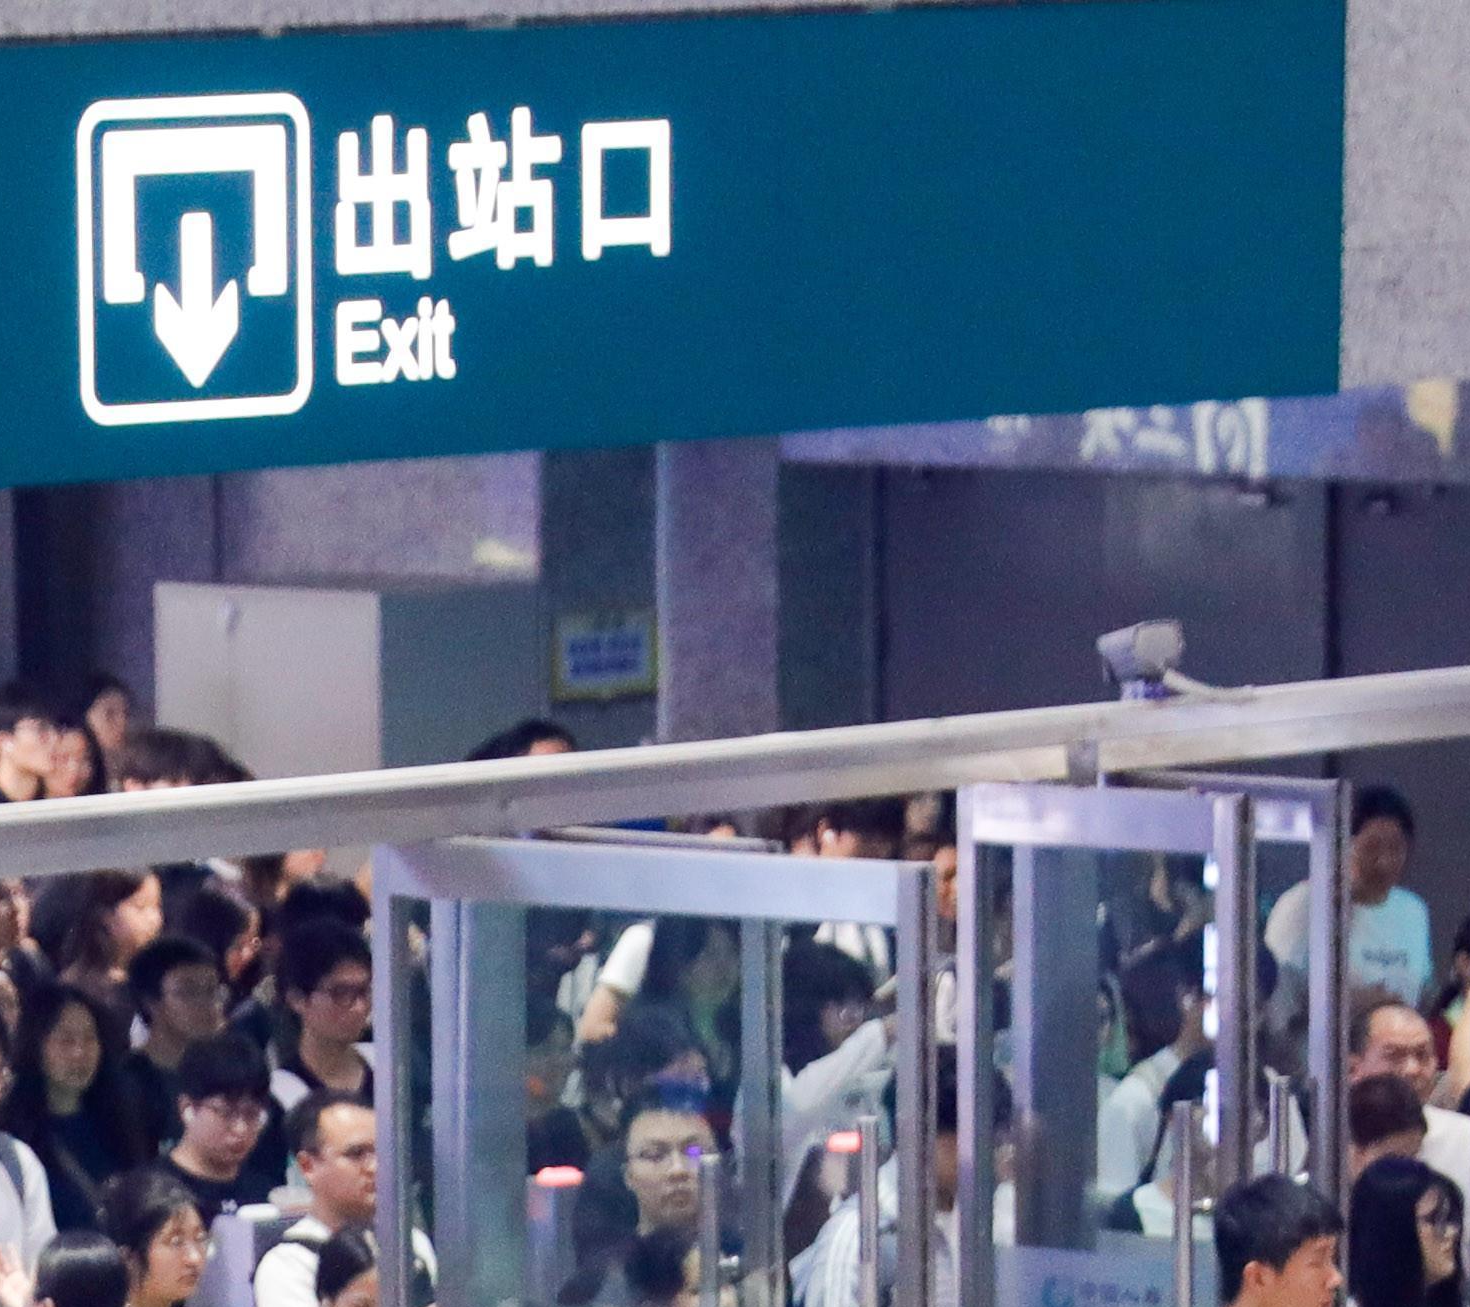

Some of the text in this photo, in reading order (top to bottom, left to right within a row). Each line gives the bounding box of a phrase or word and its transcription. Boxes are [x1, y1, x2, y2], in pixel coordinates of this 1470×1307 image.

[335, 106, 672, 281] 出站口
[335, 296, 457, 386] Exit
